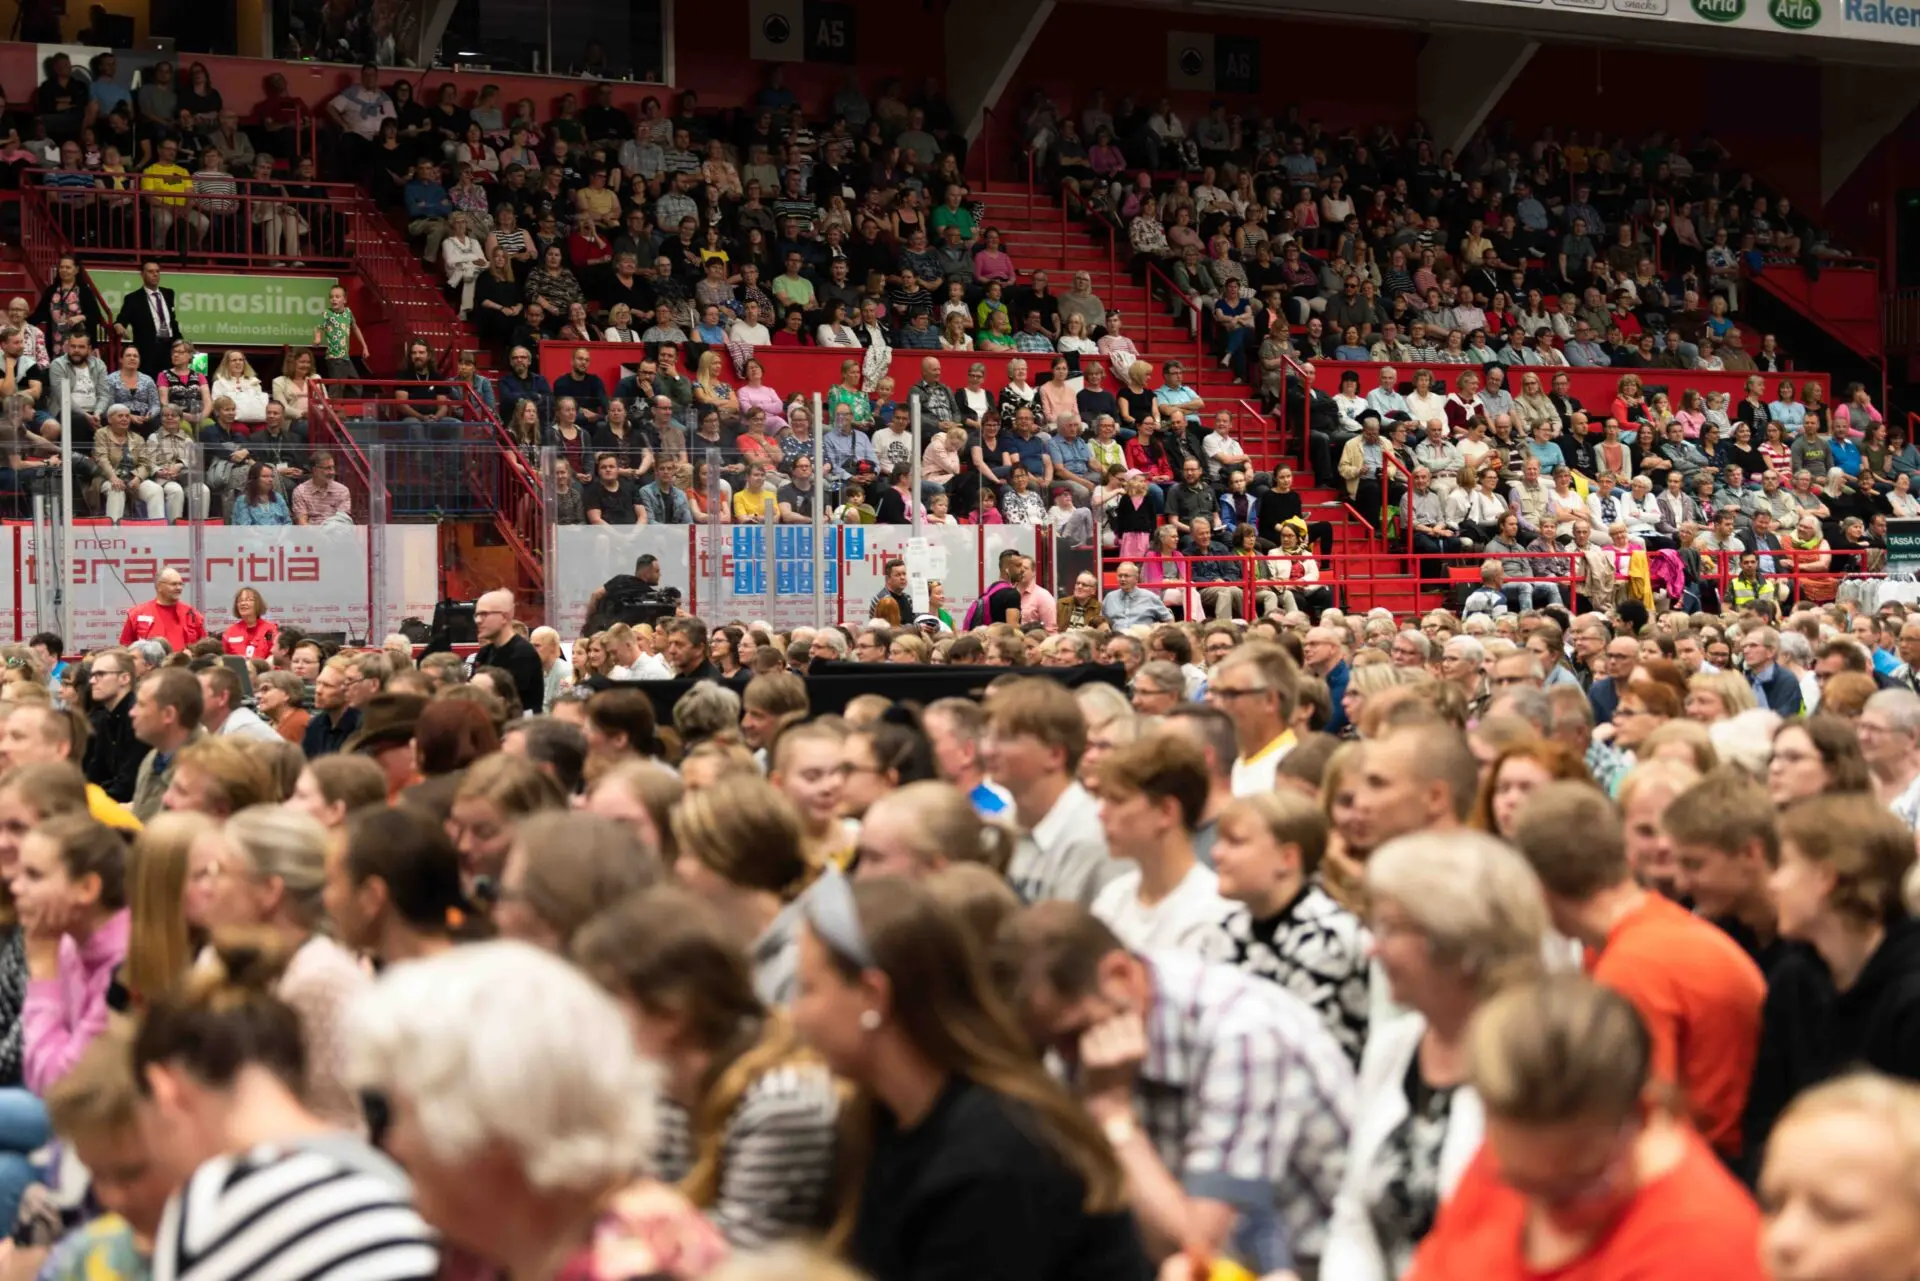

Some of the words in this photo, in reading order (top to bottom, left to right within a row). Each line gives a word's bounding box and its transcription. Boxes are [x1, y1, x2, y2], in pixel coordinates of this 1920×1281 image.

[1775, 1, 1813, 19] Arla
[815, 18, 845, 47] A5
[1225, 51, 1252, 78] A6
